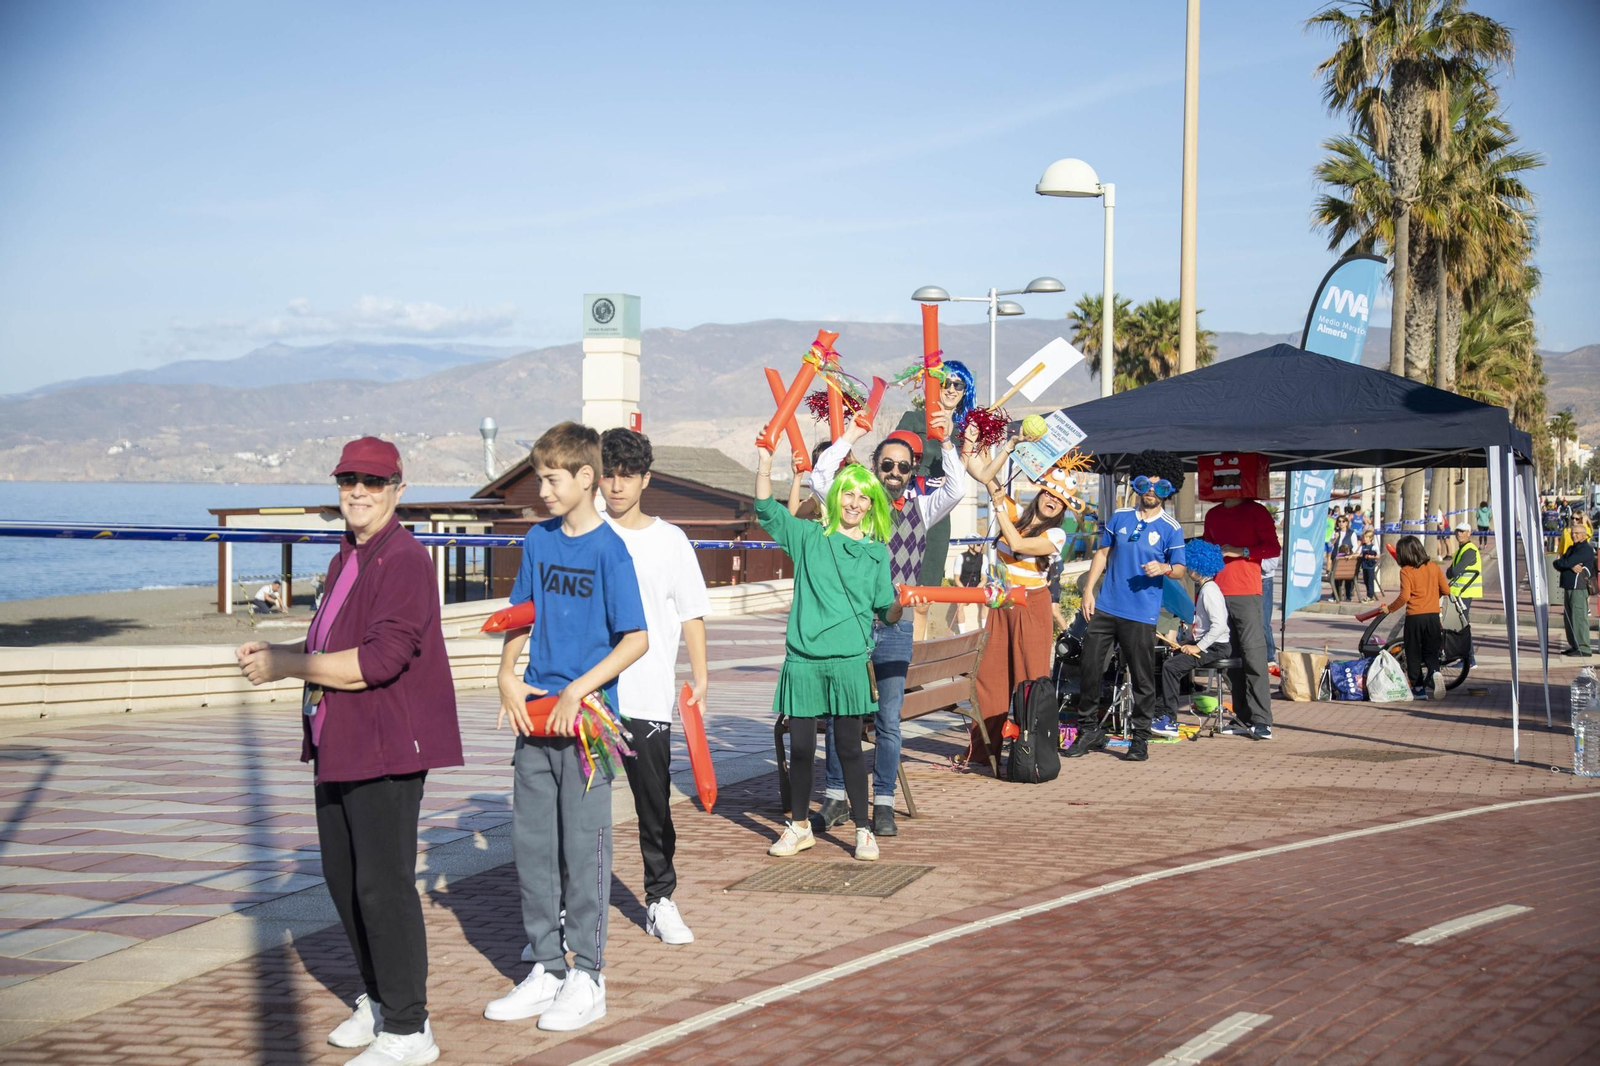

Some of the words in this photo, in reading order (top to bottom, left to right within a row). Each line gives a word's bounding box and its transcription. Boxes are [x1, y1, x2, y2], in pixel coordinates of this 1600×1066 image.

[1319, 315, 1340, 327] Medio
[1317, 323, 1348, 340] Almería
[1053, 413, 1065, 424] MEDIO
[538, 561, 595, 598] VANS
